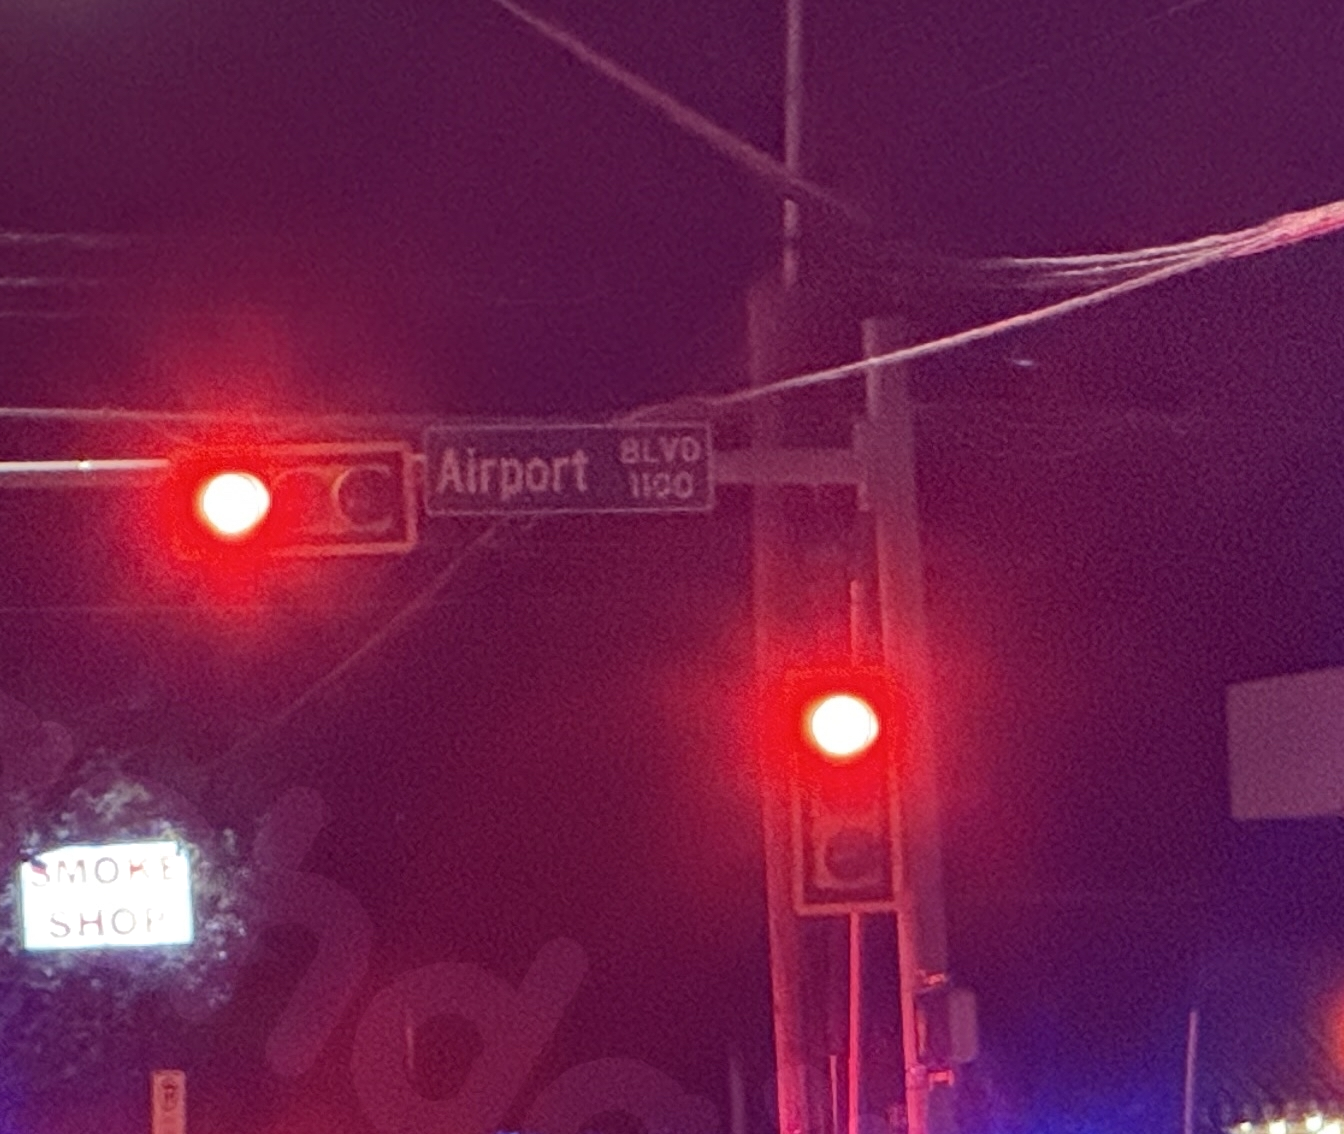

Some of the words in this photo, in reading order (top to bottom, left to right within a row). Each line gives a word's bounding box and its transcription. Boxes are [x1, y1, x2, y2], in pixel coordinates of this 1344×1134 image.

[434, 446, 589, 502] Airport
[618, 435, 701, 465] BLVD
[30, 856, 175, 888] SMOKE
[49, 907, 165, 938] SHOP
